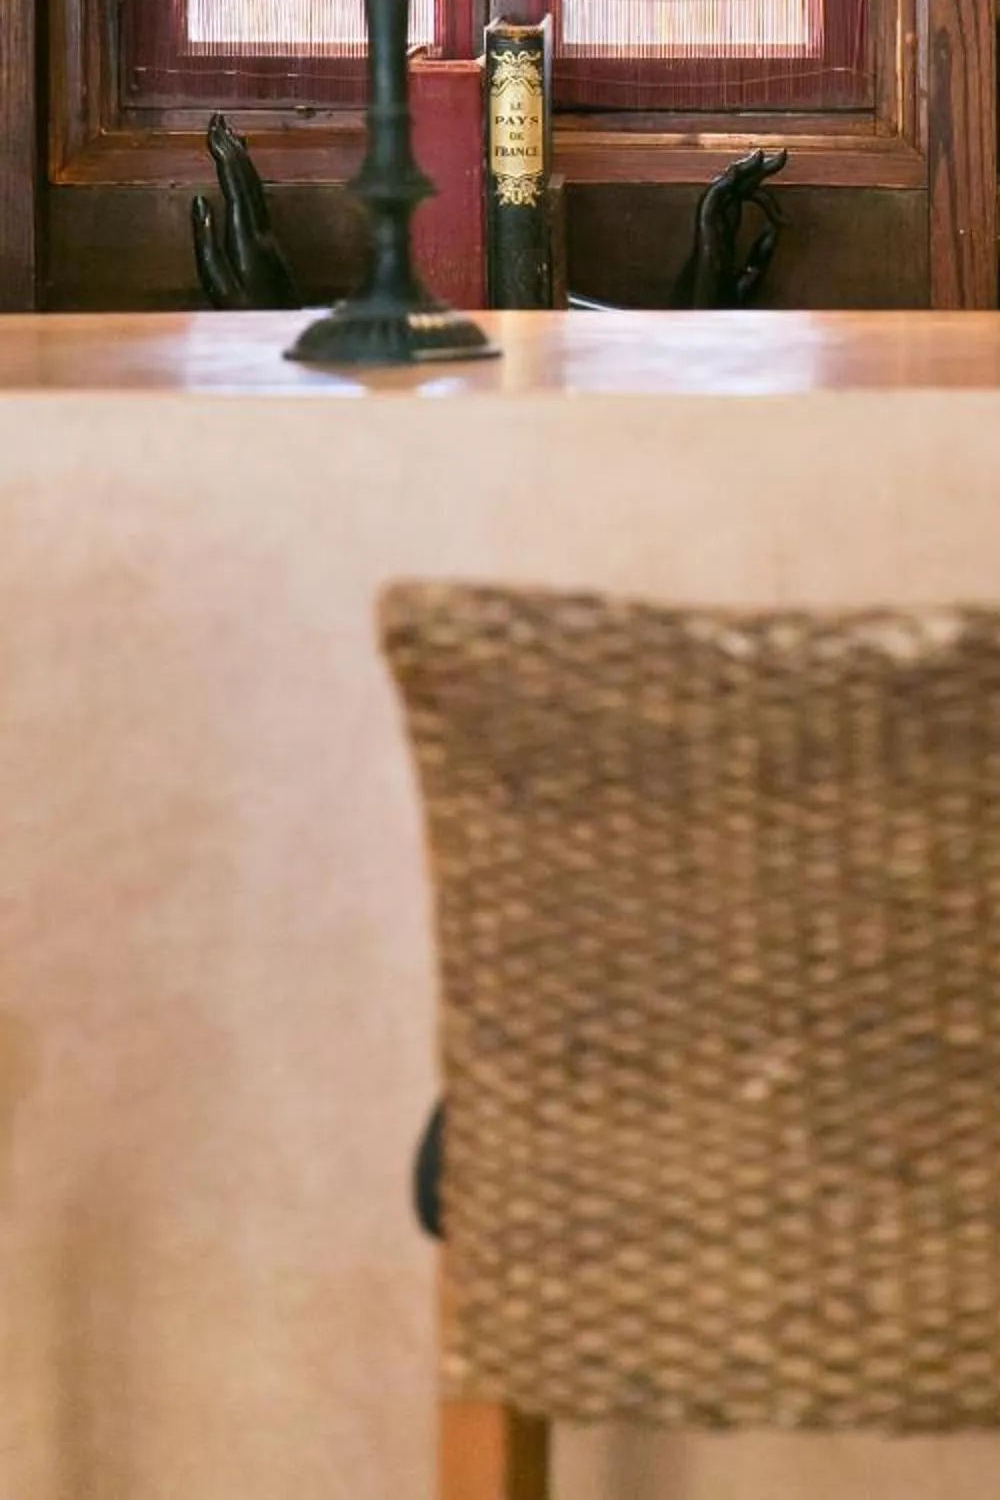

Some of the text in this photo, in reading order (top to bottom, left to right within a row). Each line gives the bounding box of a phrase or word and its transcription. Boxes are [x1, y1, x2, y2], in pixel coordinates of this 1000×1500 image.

[510, 102, 522, 111] LE
[495, 115, 539, 125] PAYS
[509, 132, 524, 141] DE
[495, 146, 538, 157] FRANCE
